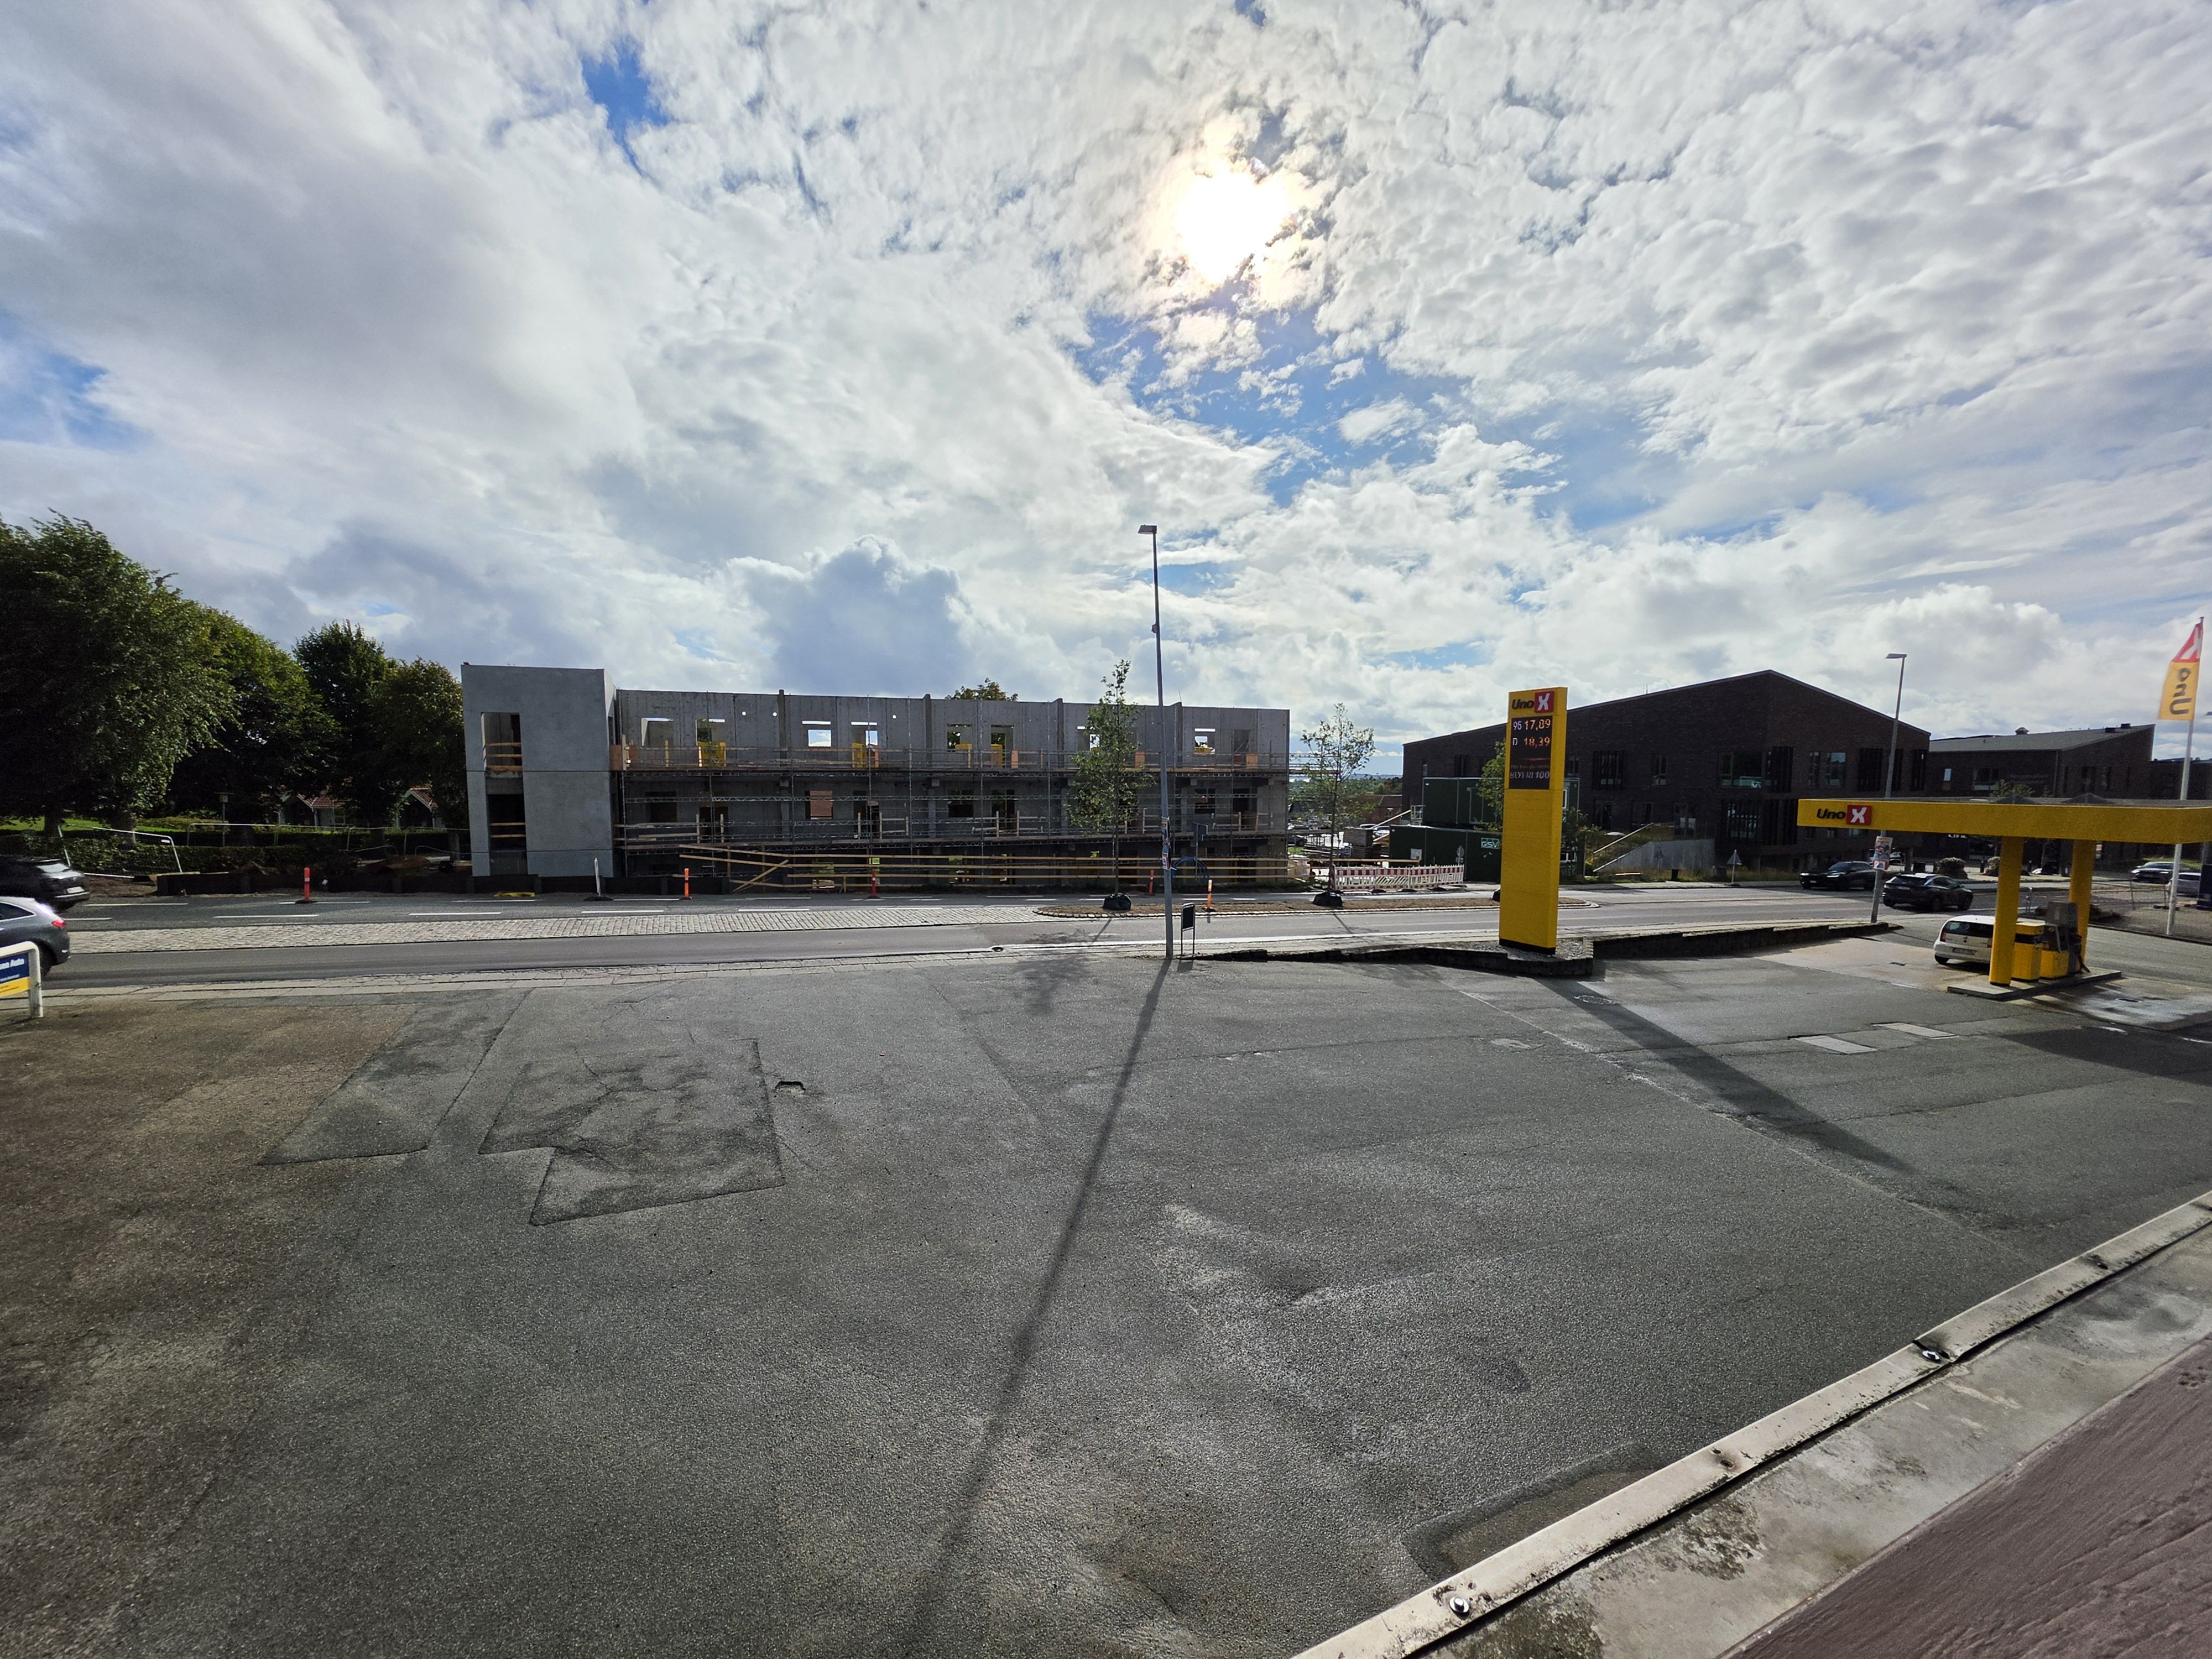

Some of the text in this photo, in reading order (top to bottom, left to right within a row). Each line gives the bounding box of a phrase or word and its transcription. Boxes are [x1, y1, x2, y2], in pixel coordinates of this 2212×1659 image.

[1512, 693, 1550, 711] Uno X
[1513, 721, 1522, 730] 95
[1512, 737, 1518, 745] D
[1817, 807, 1867, 823] Uno X
